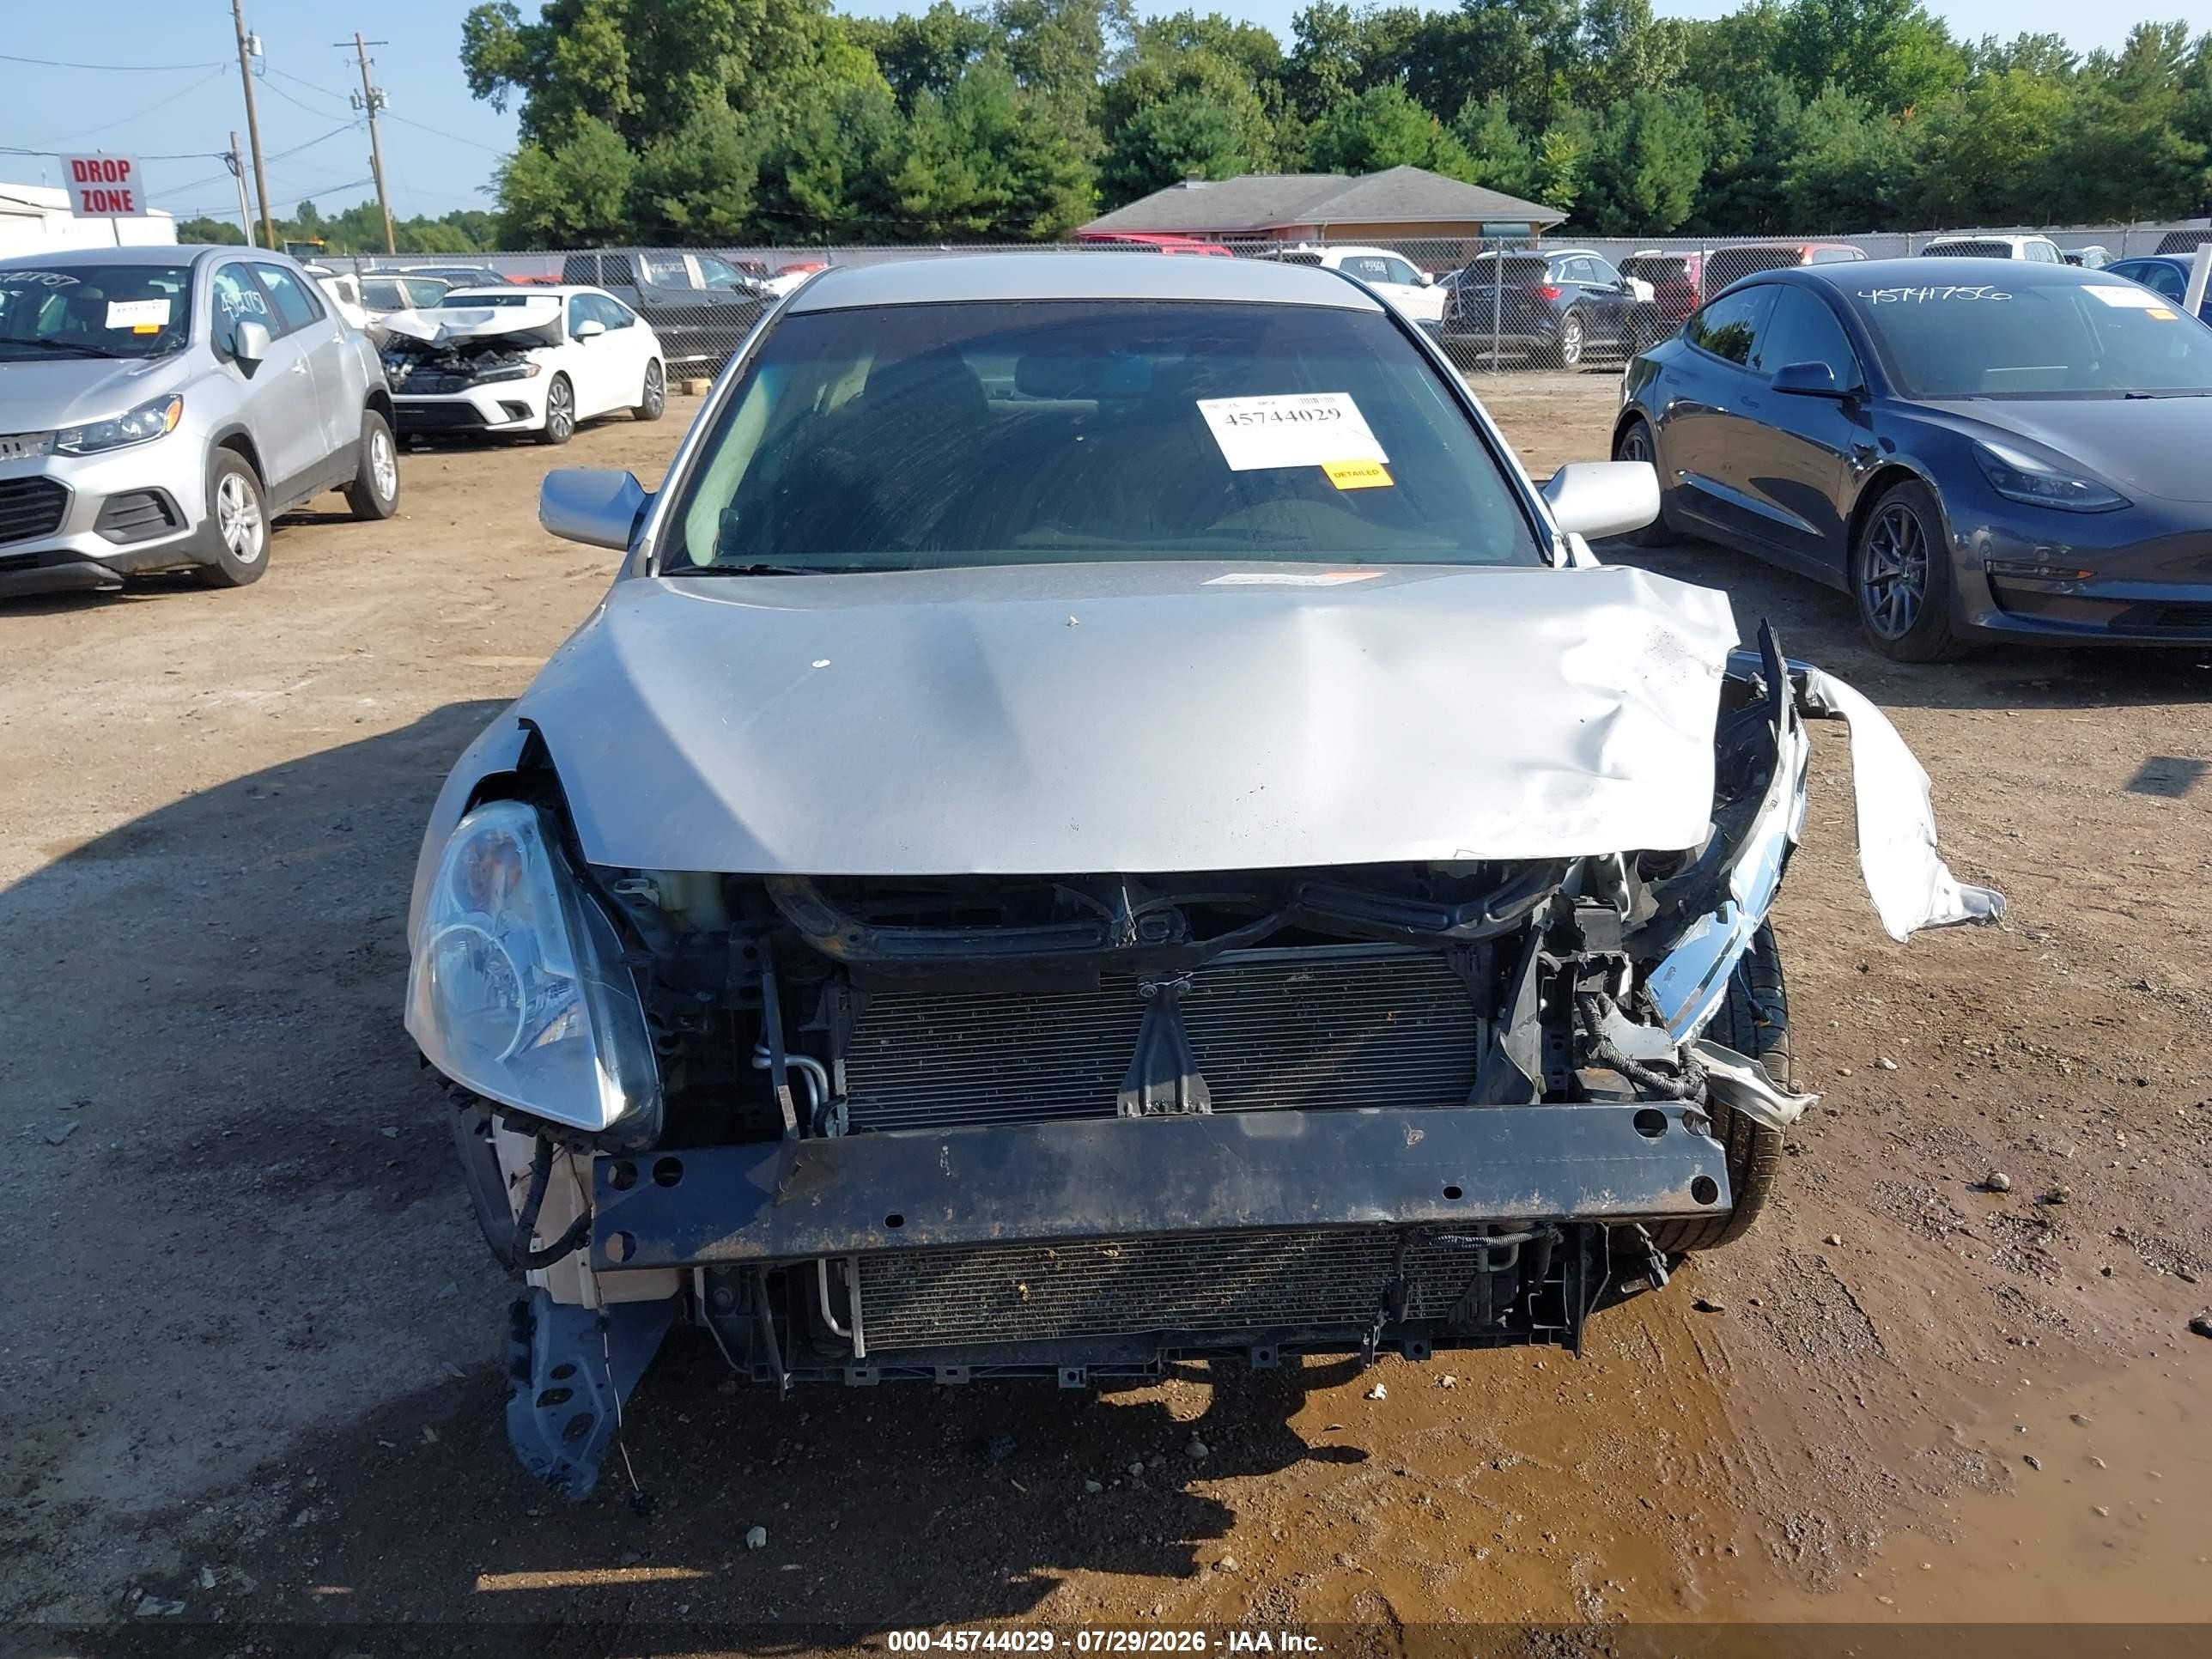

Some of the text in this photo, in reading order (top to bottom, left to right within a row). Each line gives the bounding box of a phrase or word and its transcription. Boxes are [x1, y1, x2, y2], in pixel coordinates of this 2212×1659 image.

[70, 159, 131, 183] DROP
[79, 189, 135, 213] ZONE
[1857, 285, 2014, 305] 45741756
[1224, 407, 1342, 427] 45744029
[1333, 468, 1380, 479] DETAILED
